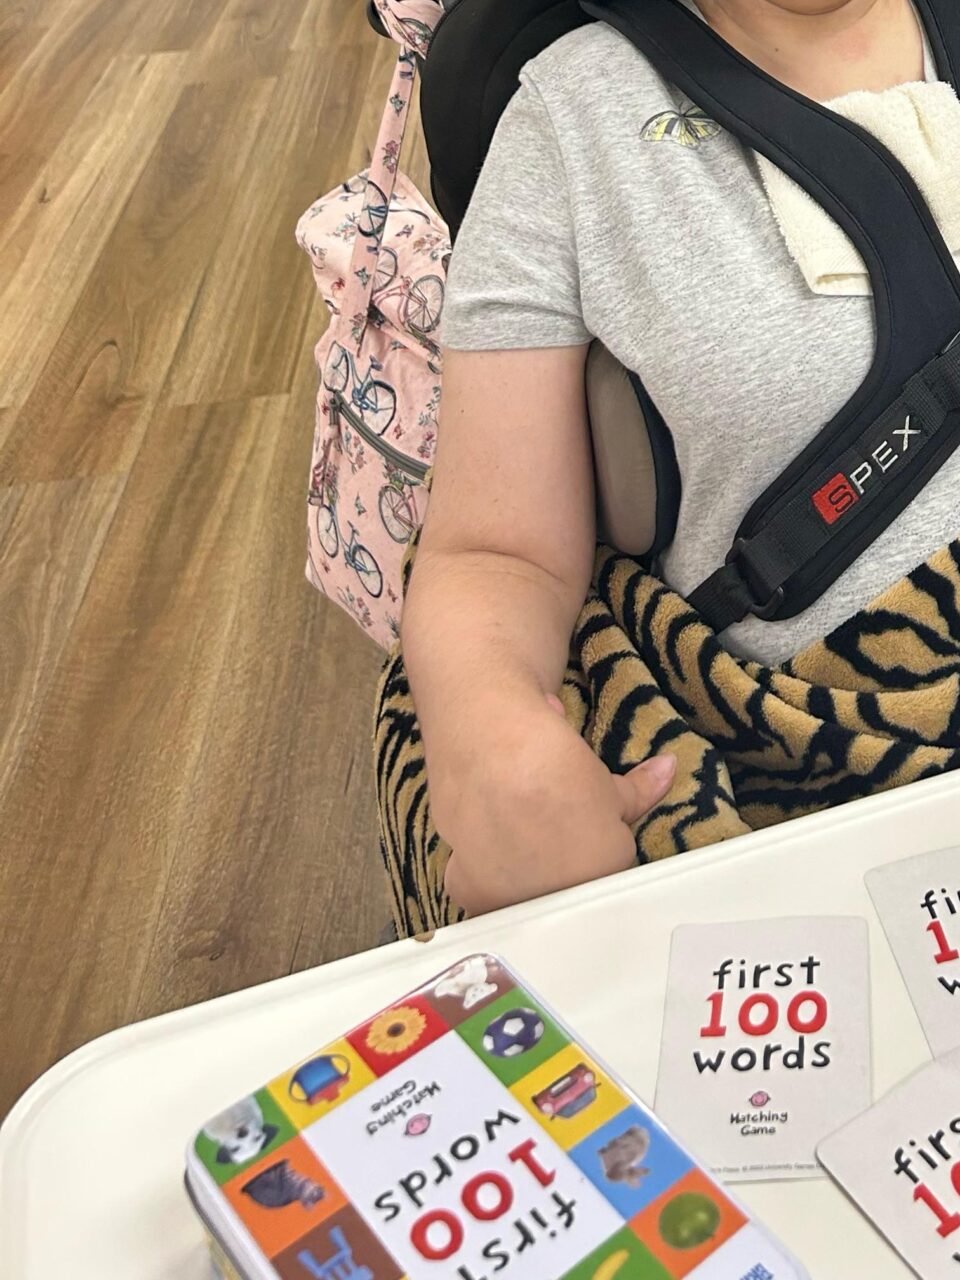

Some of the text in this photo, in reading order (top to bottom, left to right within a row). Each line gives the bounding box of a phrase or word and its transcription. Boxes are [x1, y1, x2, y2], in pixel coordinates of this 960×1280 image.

[827, 415, 921, 514] SPEX
[713, 956, 820, 989] first
[700, 990, 828, 1037] 100
[693, 1035, 831, 1074] words
[370, 1079, 417, 1113] Game
[730, 1111, 788, 1124] Matching
[740, 1125, 776, 1136] Game
[374, 1108, 521, 1223] words
[410, 1138, 558, 1261] 100
